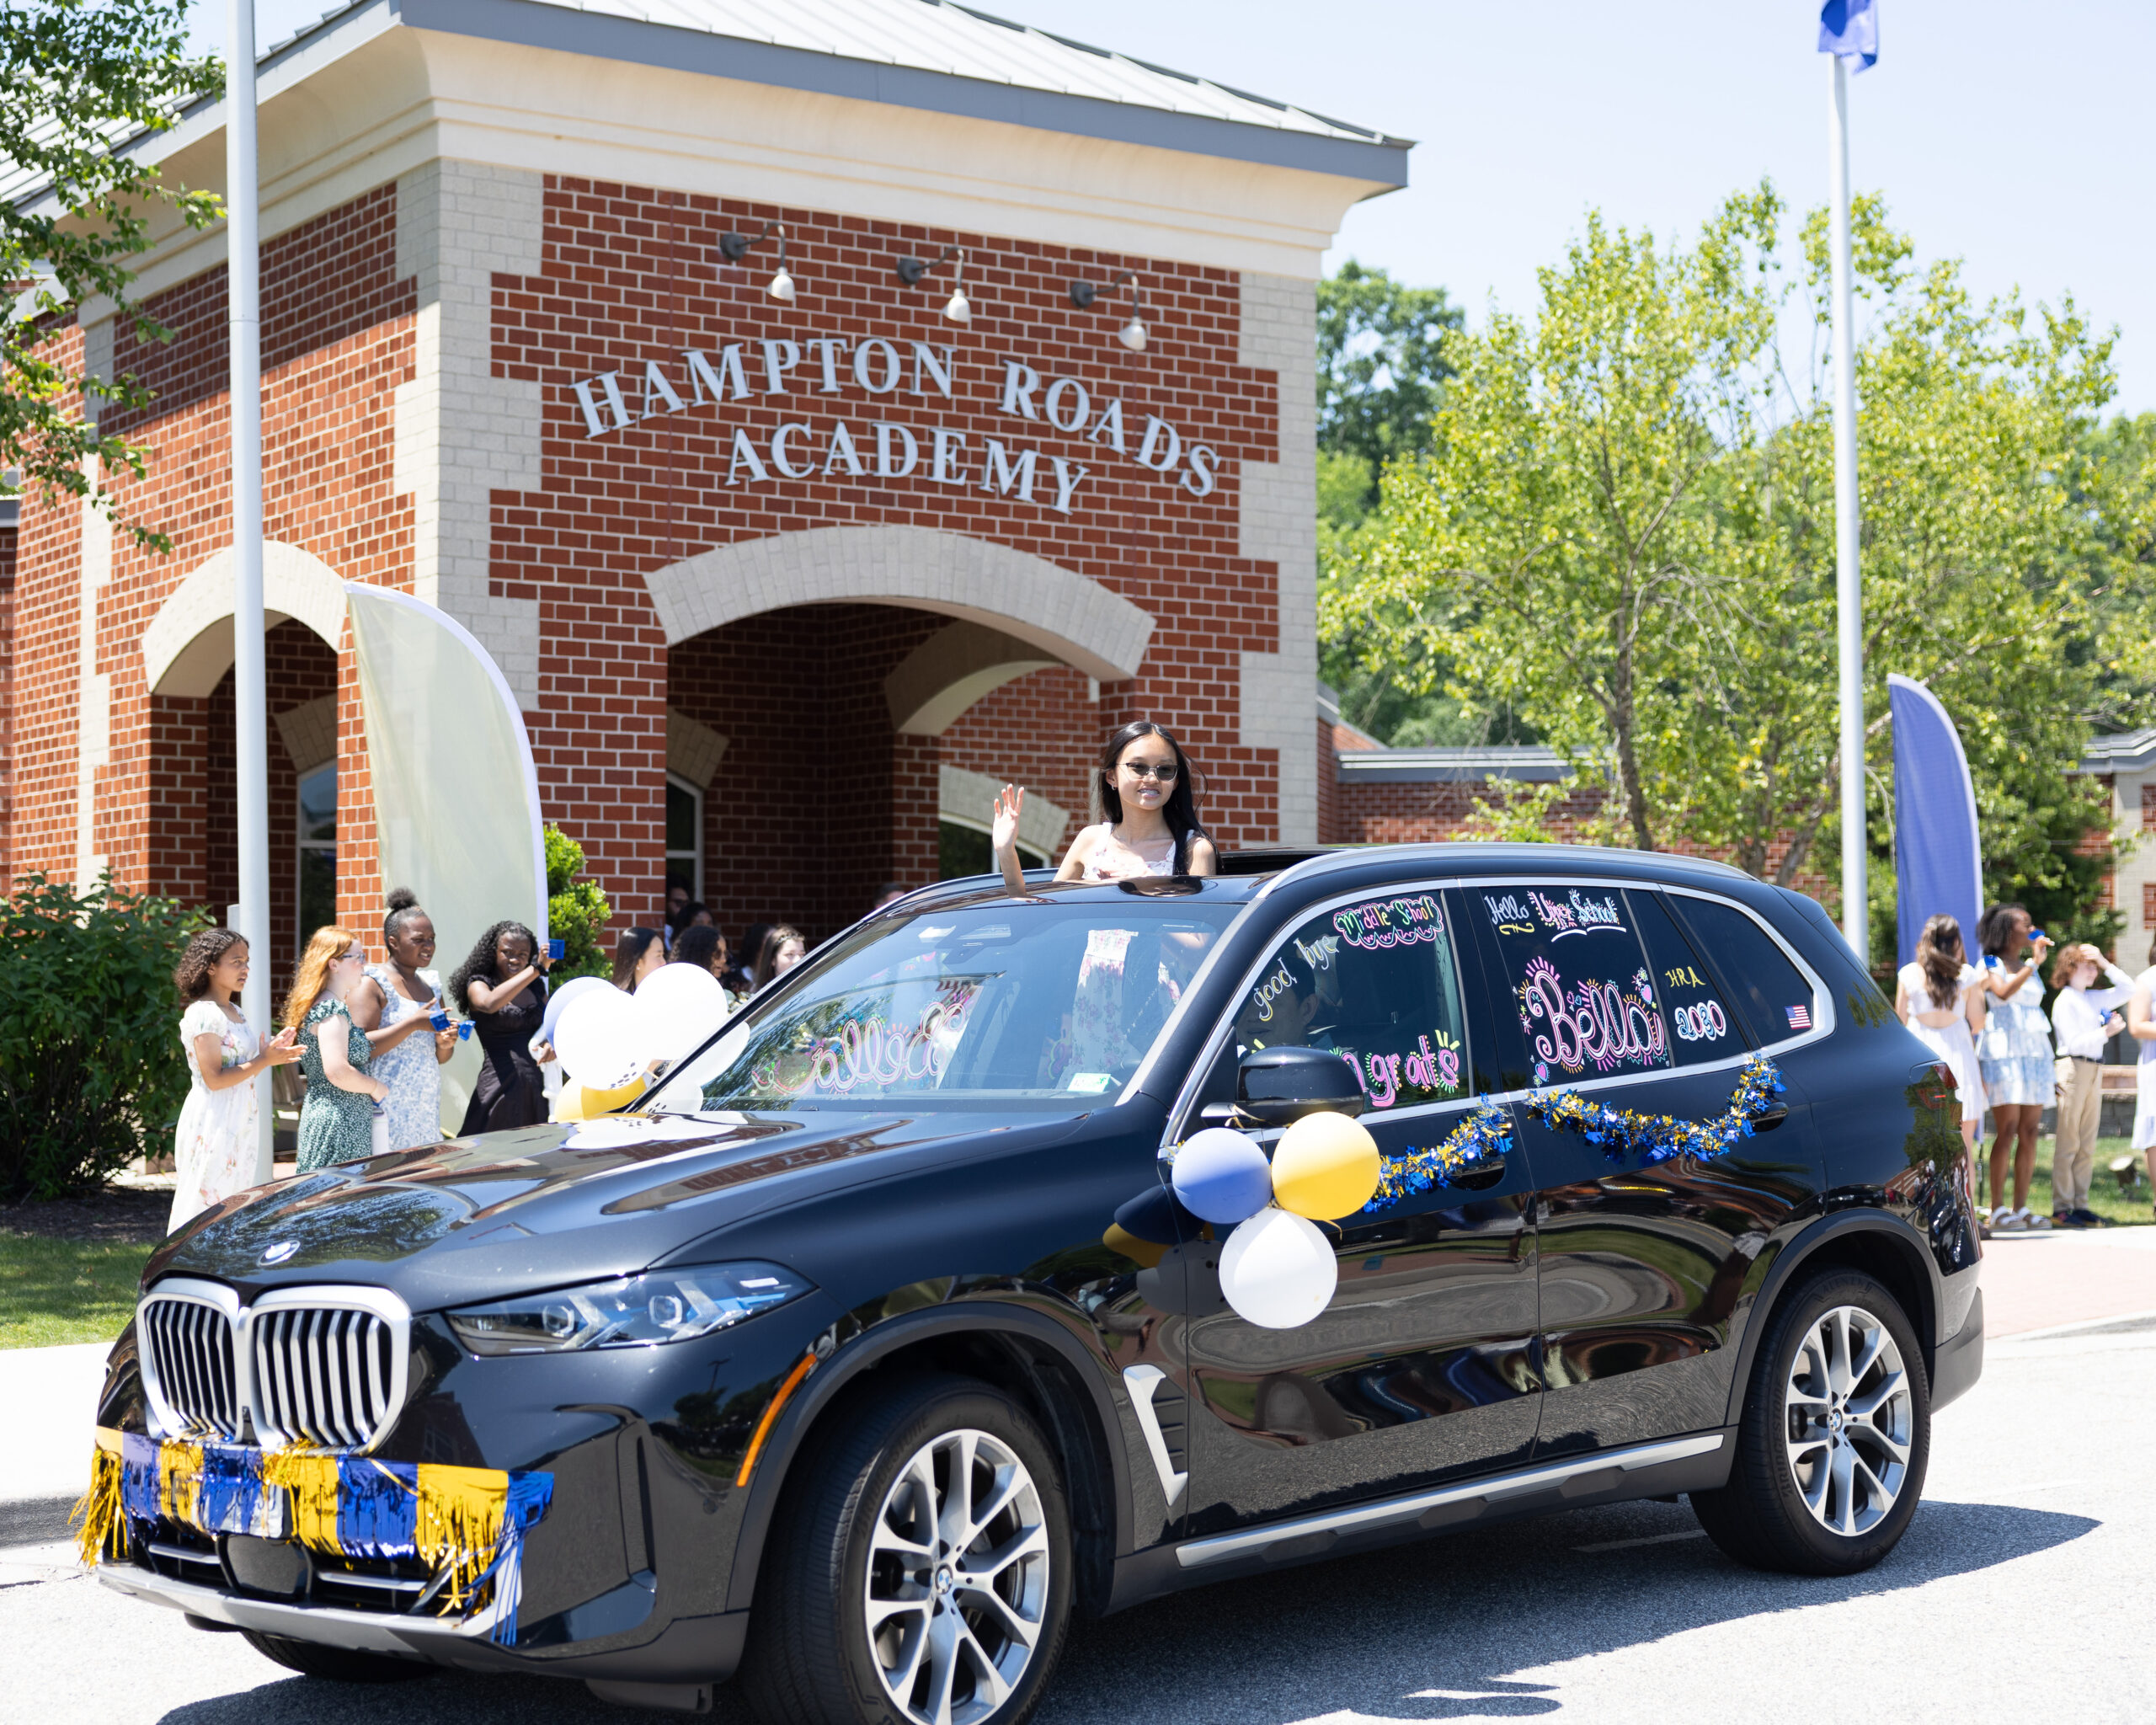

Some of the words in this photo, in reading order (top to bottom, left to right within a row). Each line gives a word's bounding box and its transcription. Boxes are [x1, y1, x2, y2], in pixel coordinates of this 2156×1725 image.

[568, 337, 958, 439] HAMPTON
[997, 359, 1222, 498] ROADS
[724, 420, 1091, 516] ACADEMY
[1337, 906, 1391, 935] Middle
[1394, 897, 1434, 925] School
[1484, 895, 1529, 925] Hello
[1529, 891, 1574, 930] Upper
[1570, 893, 1618, 924] School
[1253, 957, 1298, 1022] good
[1294, 934, 1340, 969] bye
[1666, 966, 1706, 987] HRA
[1524, 969, 1665, 1068] Bella
[1674, 1000, 1727, 1041] 2030
[1342, 1035, 1460, 1107] ngrats
[1771, 1375, 1793, 1498] BRIDGESTONE
